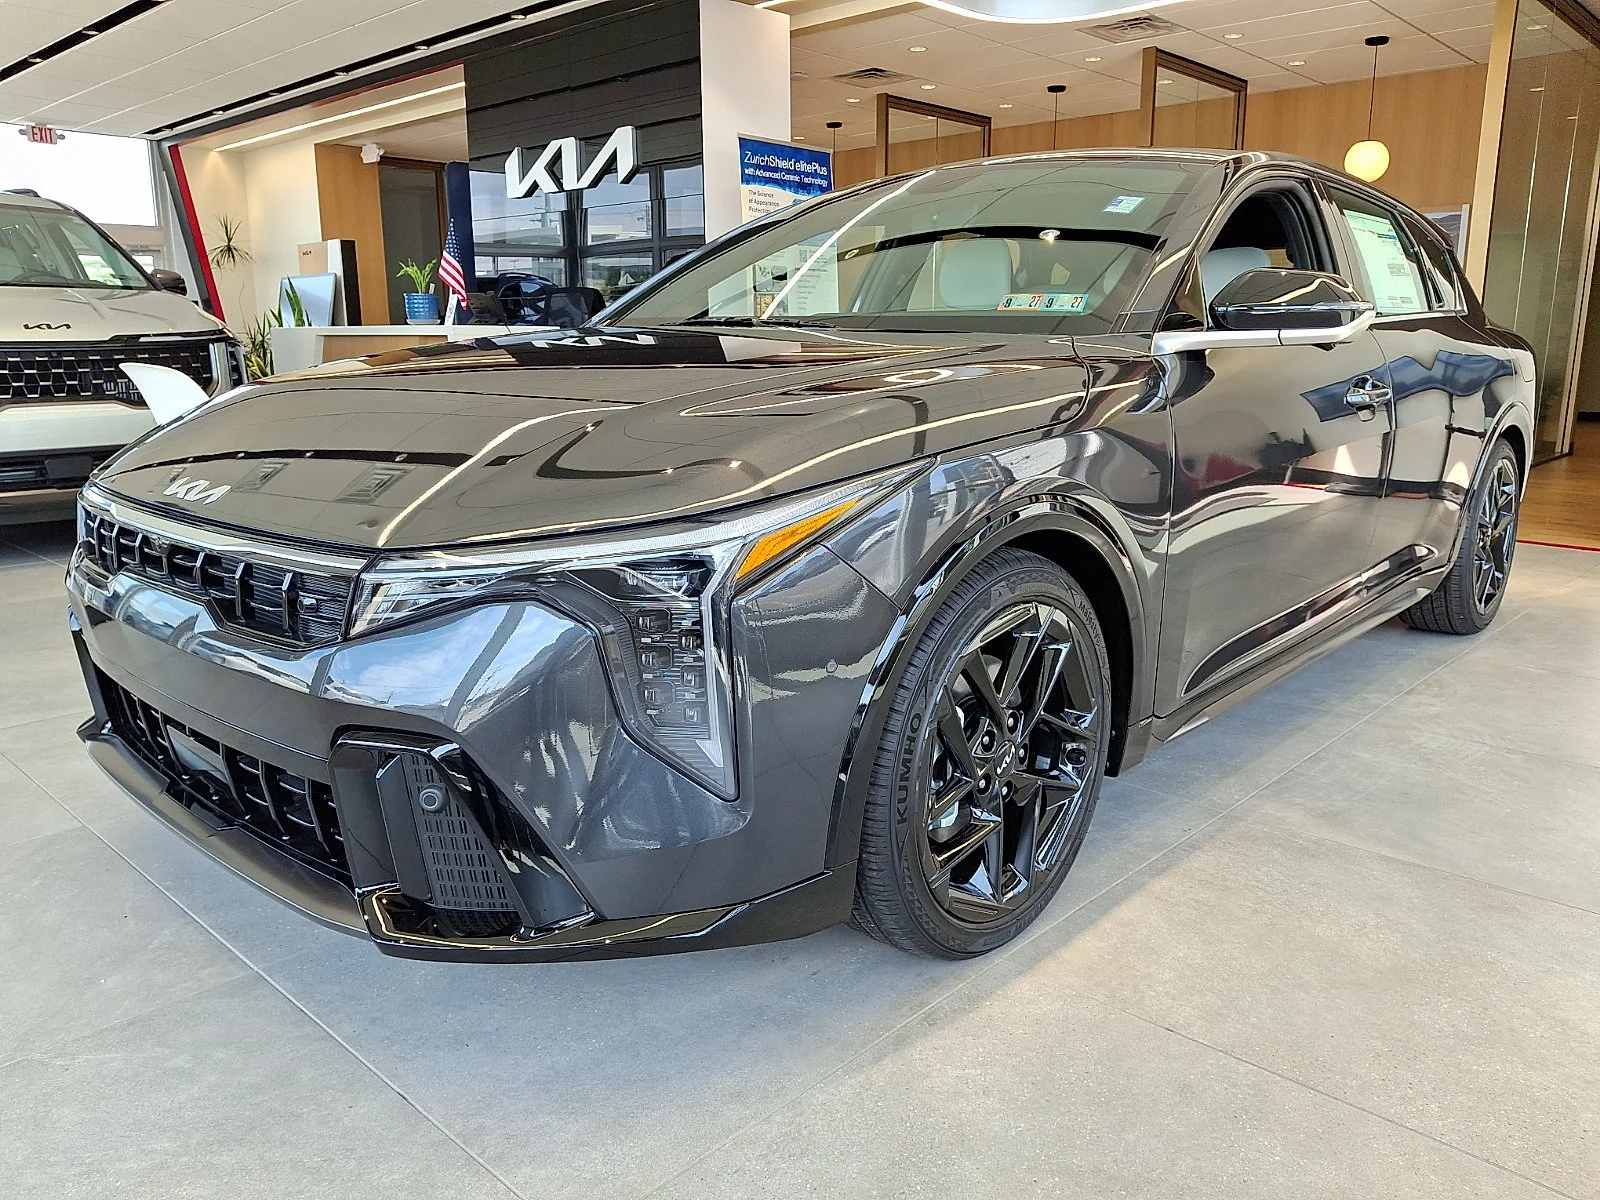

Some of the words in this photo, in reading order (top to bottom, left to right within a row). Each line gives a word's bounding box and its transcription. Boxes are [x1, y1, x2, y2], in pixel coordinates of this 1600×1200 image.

[31, 125, 54, 144] EXIT
[504, 125, 638, 199] KIA
[744, 151, 795, 171] ZurichShield
[744, 167, 755, 175] with
[755, 168, 781, 180] Advanced
[780, 171, 801, 183] Ceramic
[800, 174, 829, 188] Technology
[754, 198, 780, 207] Appearance
[757, 190, 774, 199] Science
[1003, 297, 1013, 309] 9
[1028, 295, 1042, 308] 27
[1045, 297, 1055, 309] 9
[1070, 296, 1084, 309] 27
[163, 476, 232, 505] KIA
[896, 712, 922, 826] KUMHO
[996, 744, 1016, 775] KIA
